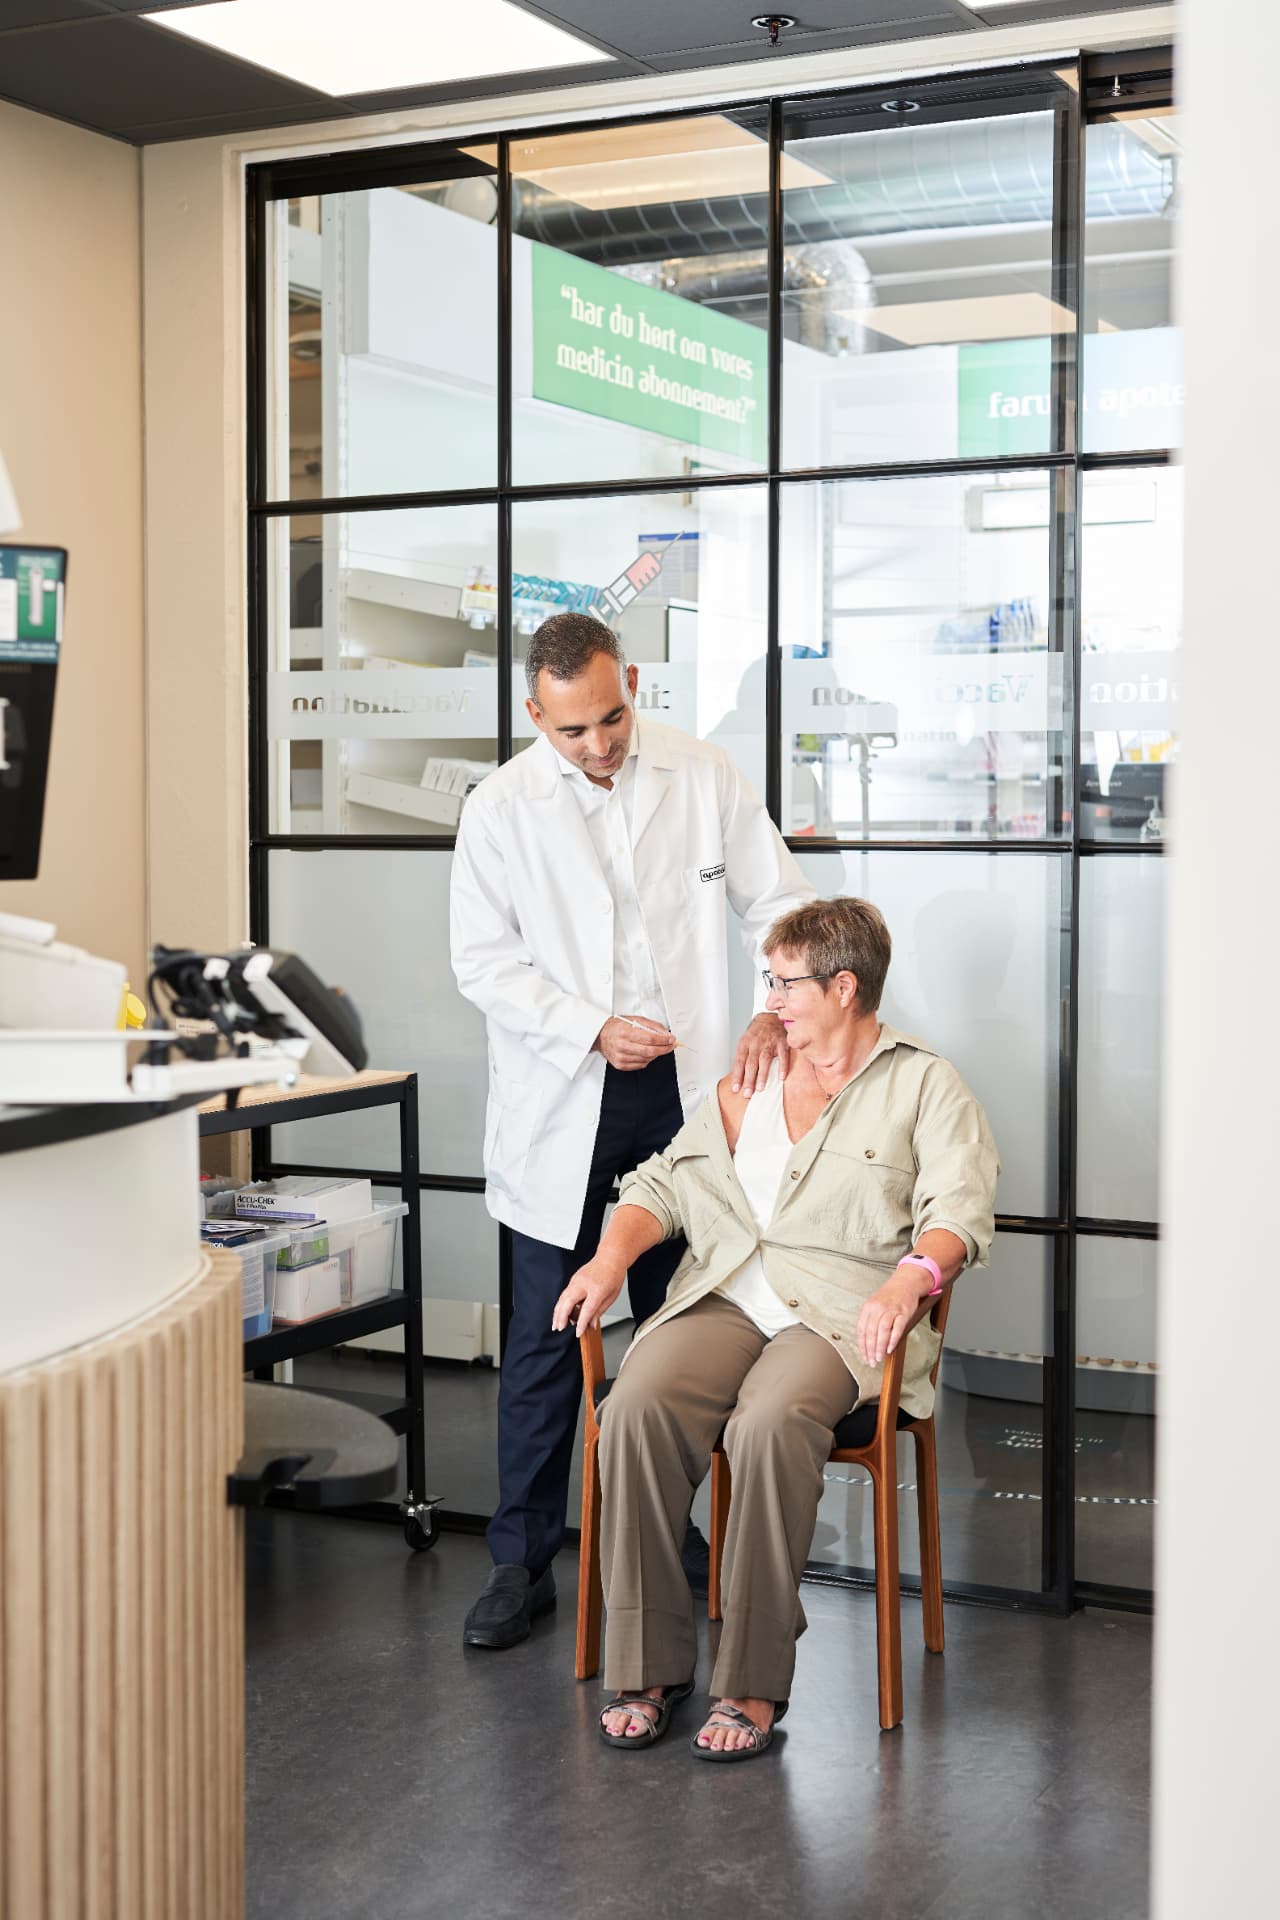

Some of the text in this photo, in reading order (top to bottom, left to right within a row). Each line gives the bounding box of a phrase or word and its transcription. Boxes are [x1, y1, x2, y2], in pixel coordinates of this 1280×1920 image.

[556, 343, 634, 389] medicin
[609, 304, 633, 338] du
[639, 311, 676, 354] hørt
[680, 336, 707, 365] om
[710, 348, 752, 380] vores
